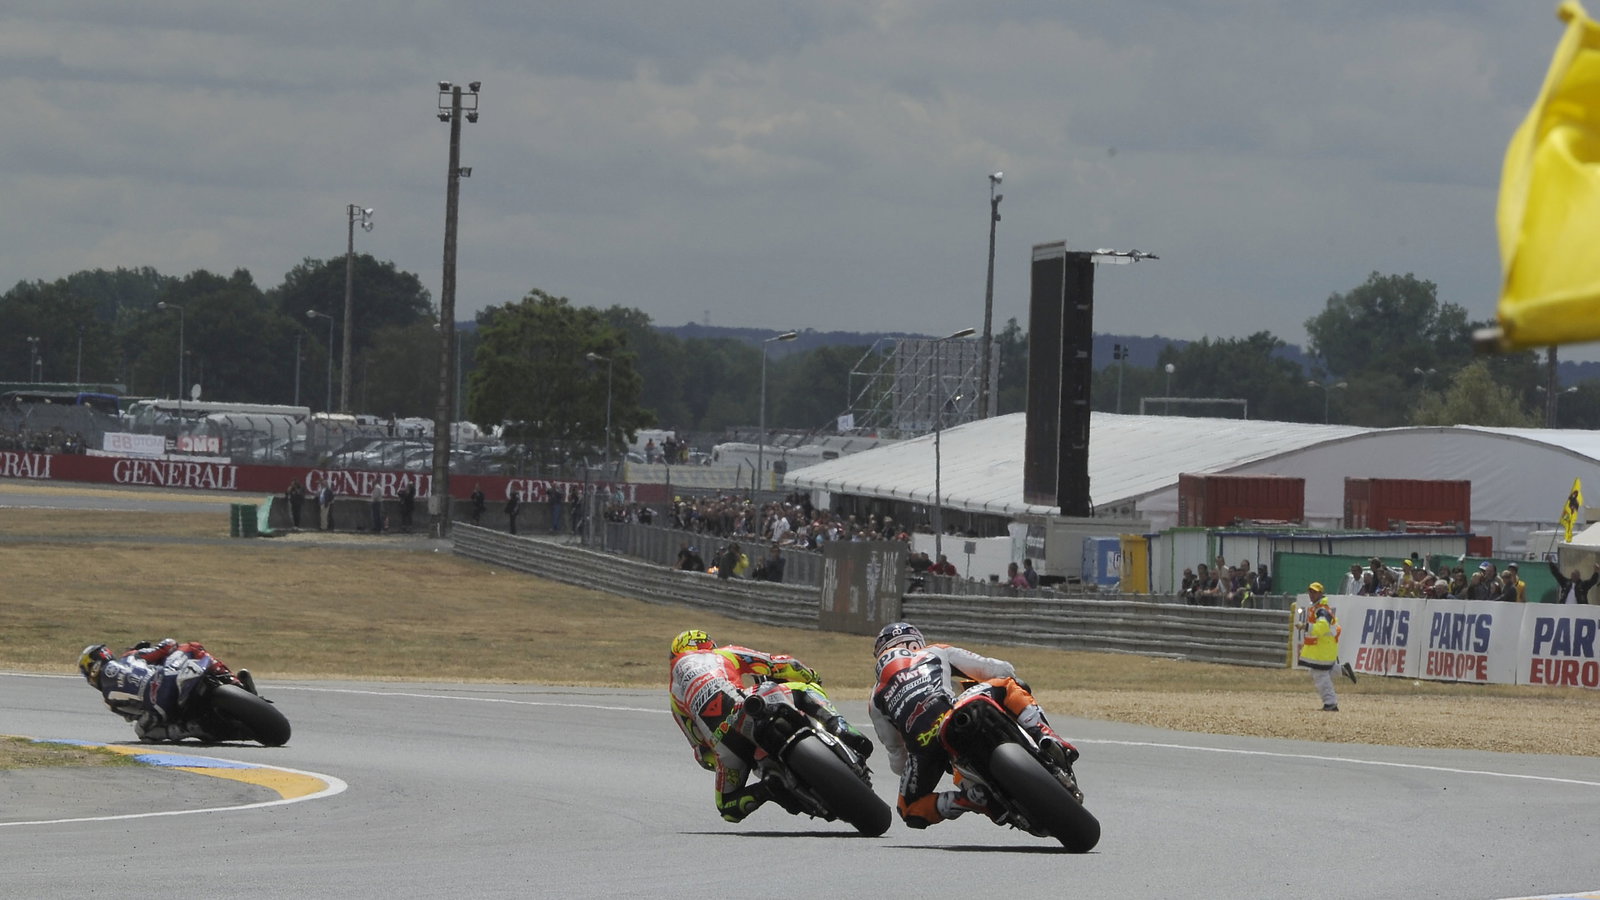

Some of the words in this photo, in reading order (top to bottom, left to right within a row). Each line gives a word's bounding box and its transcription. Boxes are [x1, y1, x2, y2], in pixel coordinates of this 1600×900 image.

[0, 451, 53, 478] RALI
[112, 459, 239, 490] GENERALI
[506, 479, 638, 503] GEERAI
[1429, 612, 1492, 653] PARTS
[1533, 617, 1600, 658] PAR
[875, 649, 917, 680] EPSO
[1426, 651, 1488, 680] EUROPE
